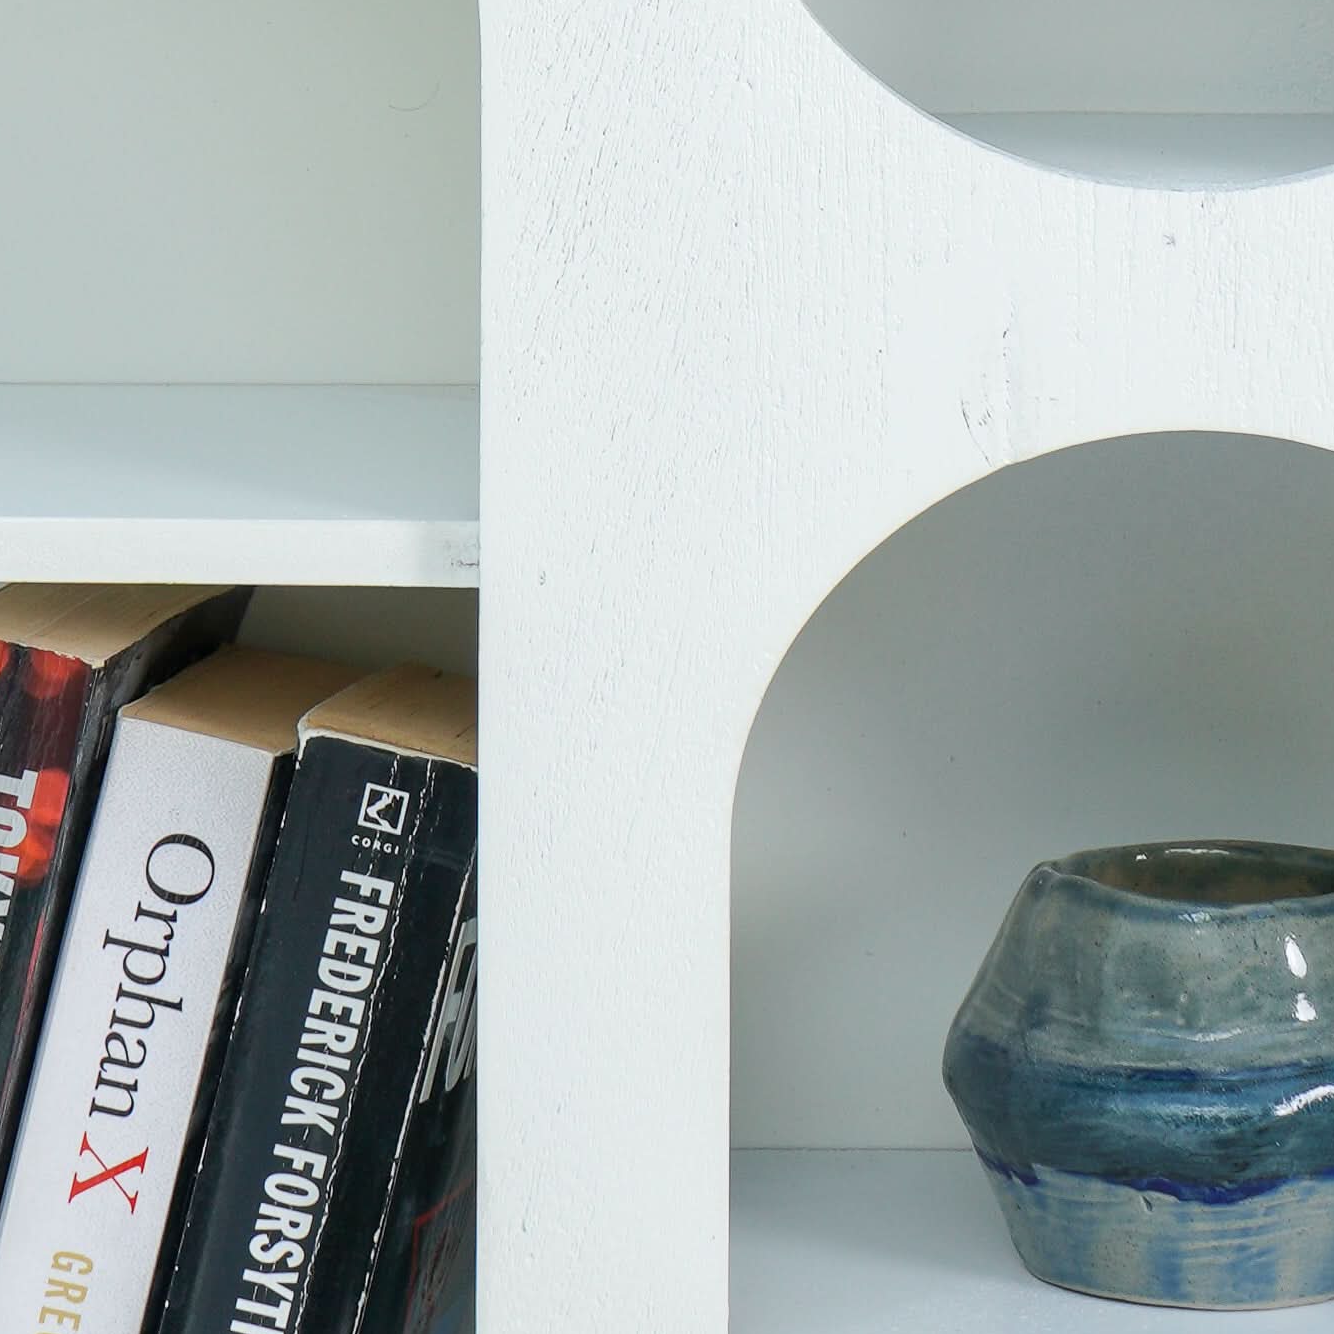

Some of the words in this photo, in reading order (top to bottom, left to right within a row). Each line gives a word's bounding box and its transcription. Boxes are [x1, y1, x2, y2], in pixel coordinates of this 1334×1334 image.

[351, 835, 400, 855] CORGI
[87, 833, 216, 1119] Orphan
[279, 869, 395, 1138] FREDERICK
[67, 1131, 150, 1214] X
